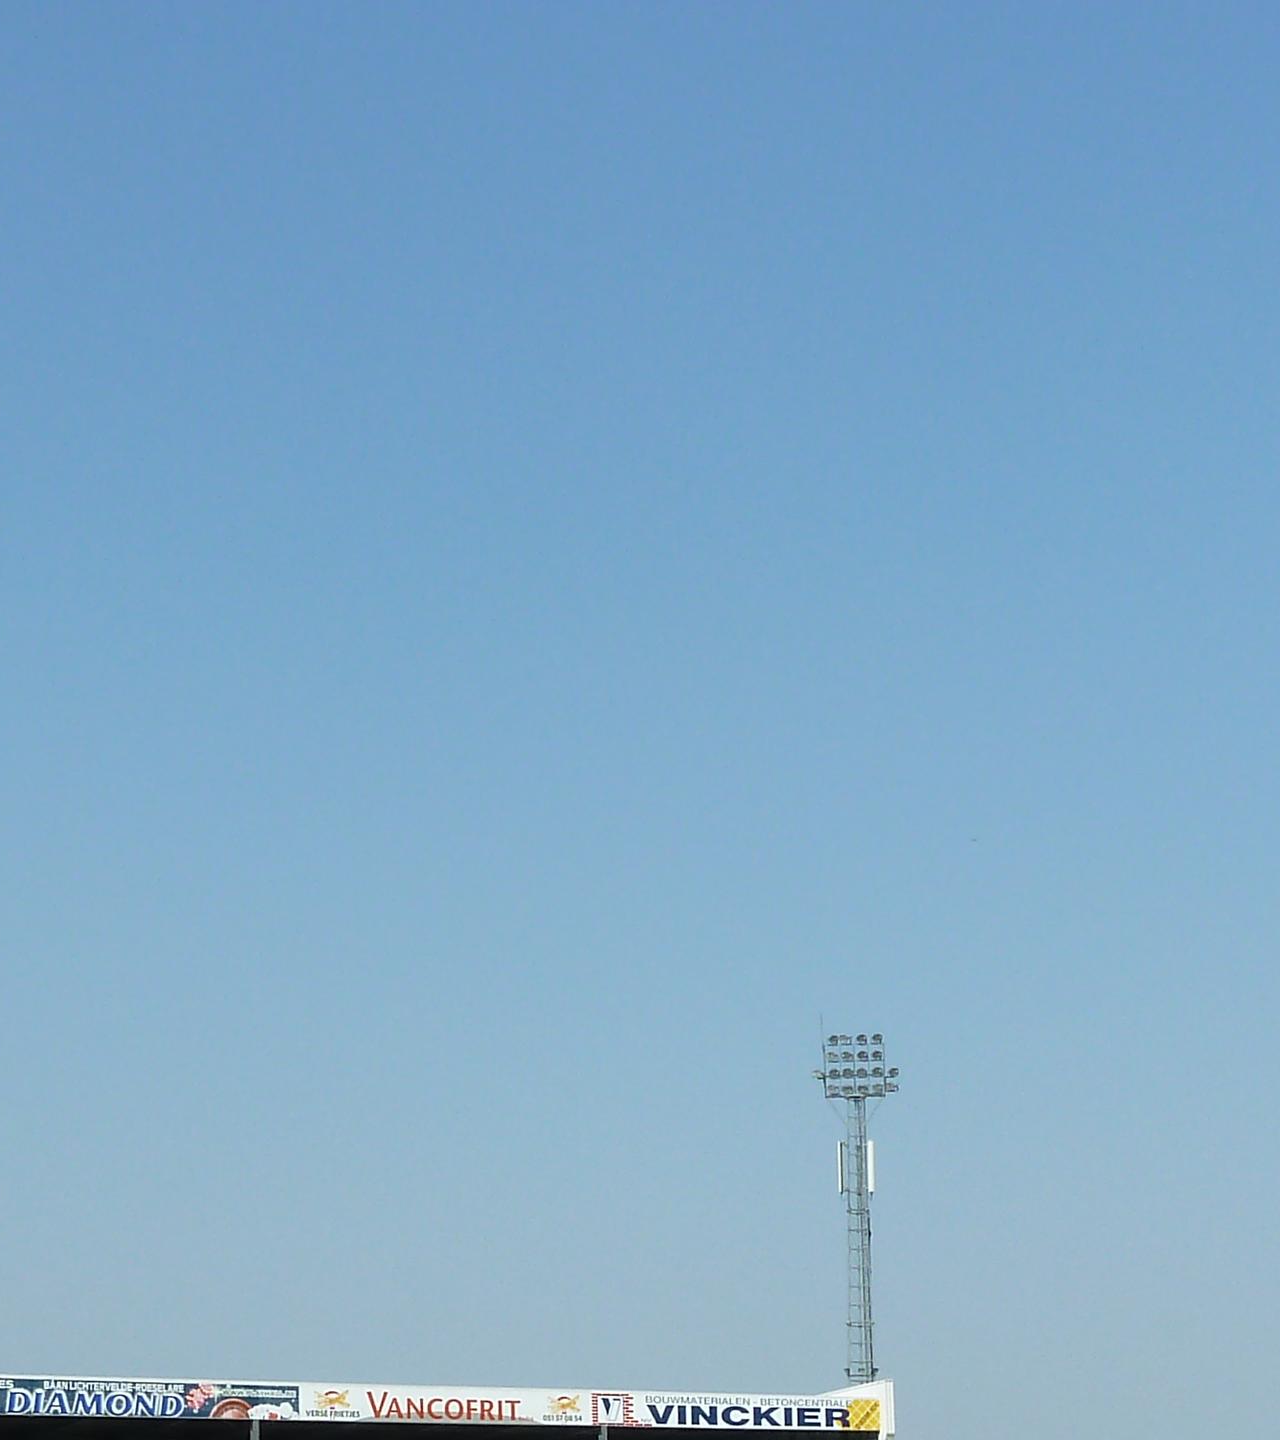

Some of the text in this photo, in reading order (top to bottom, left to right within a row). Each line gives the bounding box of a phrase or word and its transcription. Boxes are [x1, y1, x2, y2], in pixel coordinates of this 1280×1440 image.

[5, 1388, 186, 1418] DIAMOND
[367, 1391, 521, 1421] VANCOFRIT
[645, 1395, 751, 1406] BOUWMATERIALEN
[646, 1404, 851, 1428] VINCKIER
